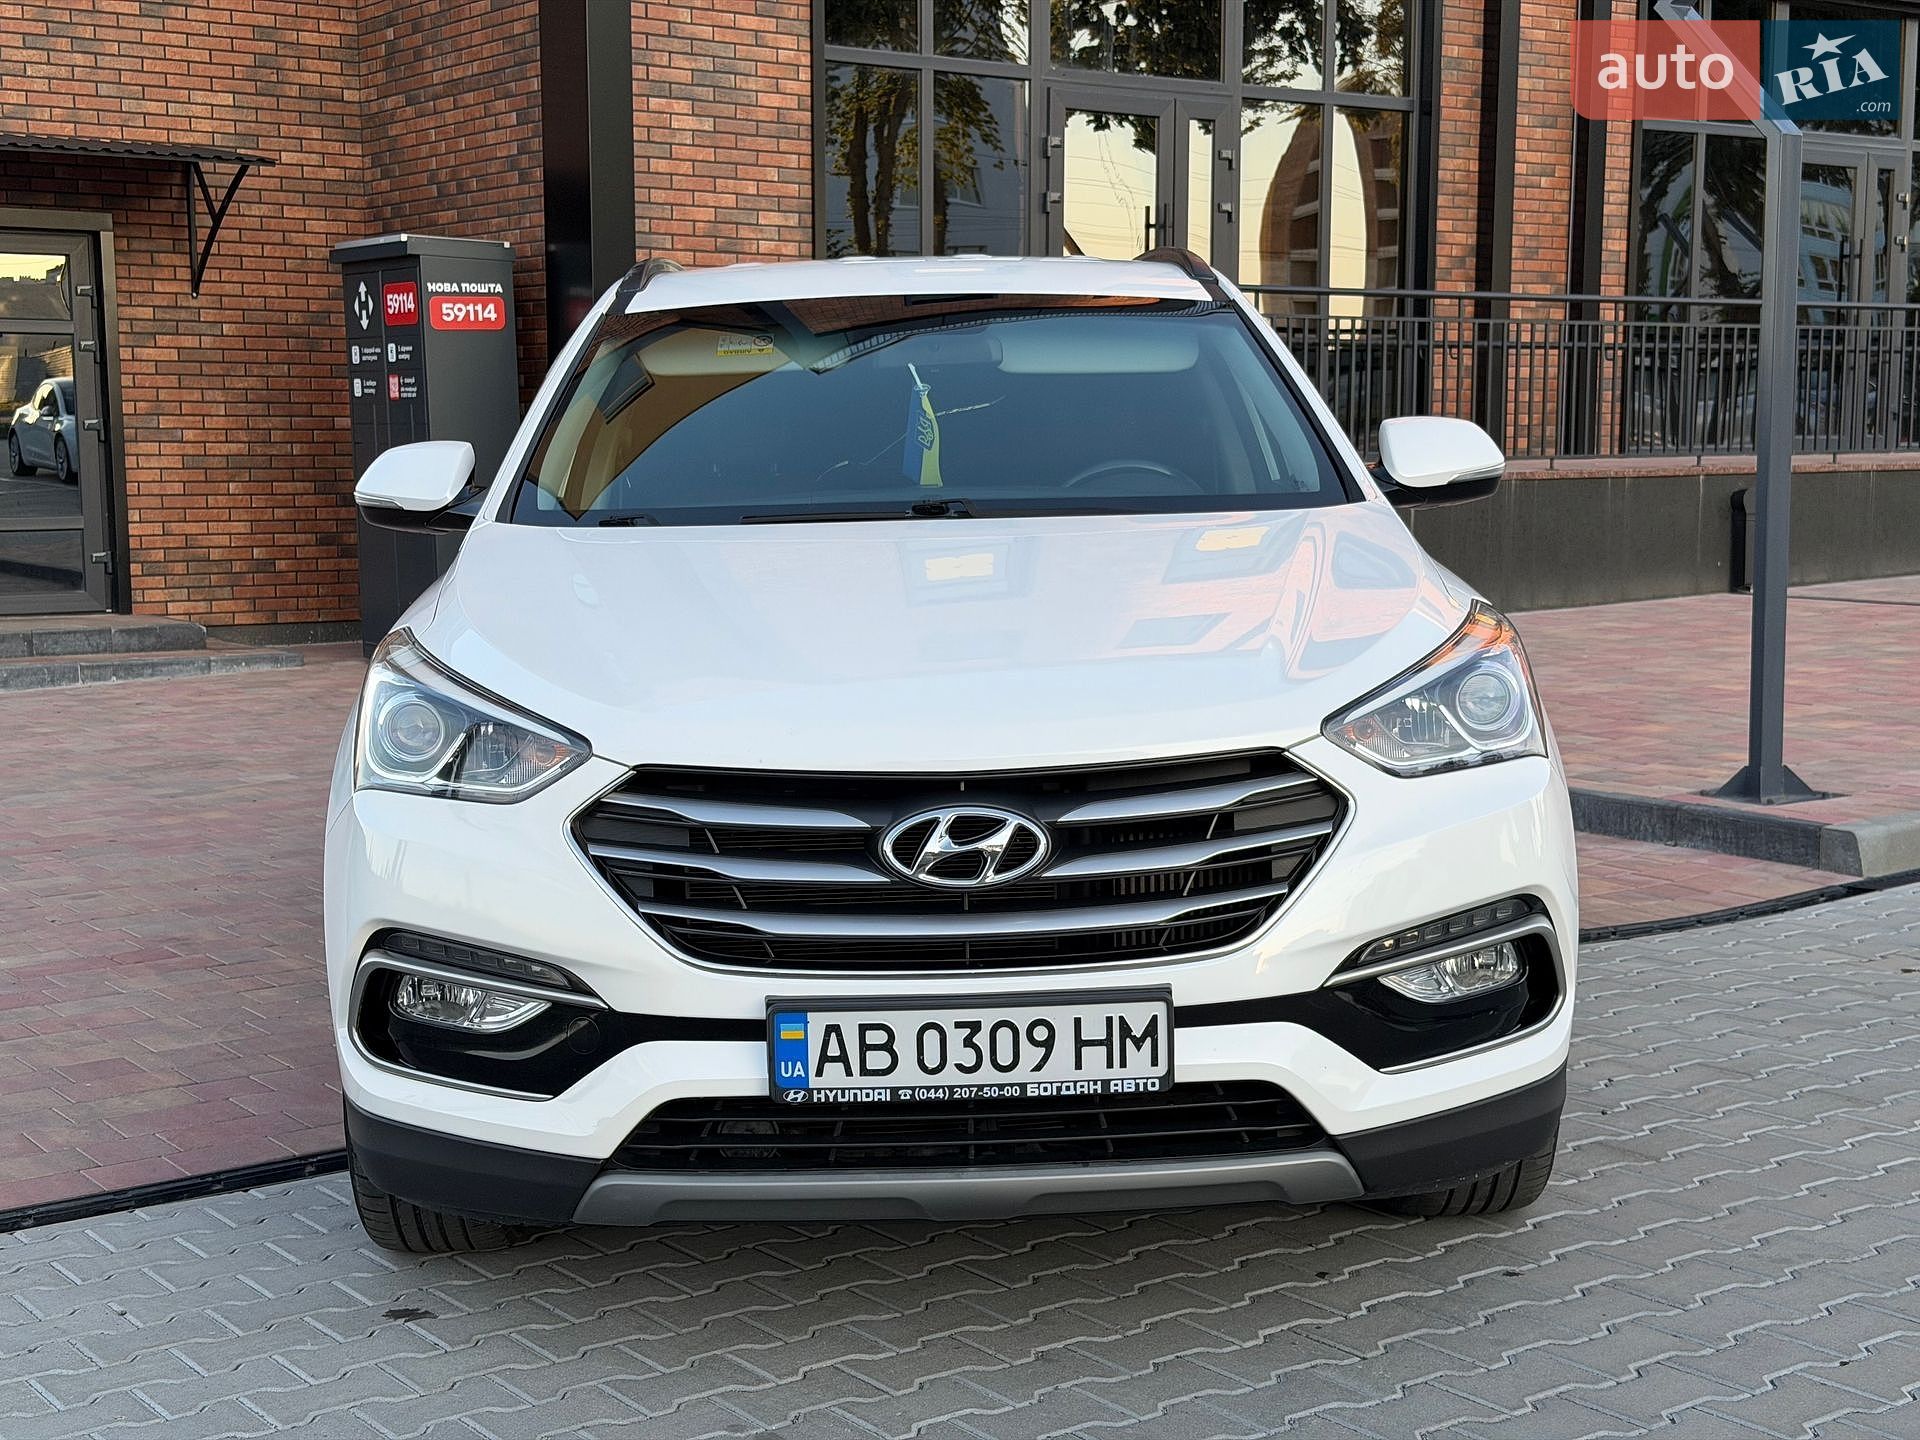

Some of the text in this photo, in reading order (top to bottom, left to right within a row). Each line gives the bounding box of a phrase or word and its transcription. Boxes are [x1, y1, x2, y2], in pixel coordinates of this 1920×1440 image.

[427, 282, 503, 294] НОВА ПОШТА
[386, 292, 415, 316] 59114
[441, 303, 498, 322] 59114
[814, 1014, 1159, 1078] AB 0309 HM
[781, 1061, 806, 1079] UA
[813, 1078, 1160, 1103] HYUNDAI (044) 207-50-00 БОГДАН АВТО
